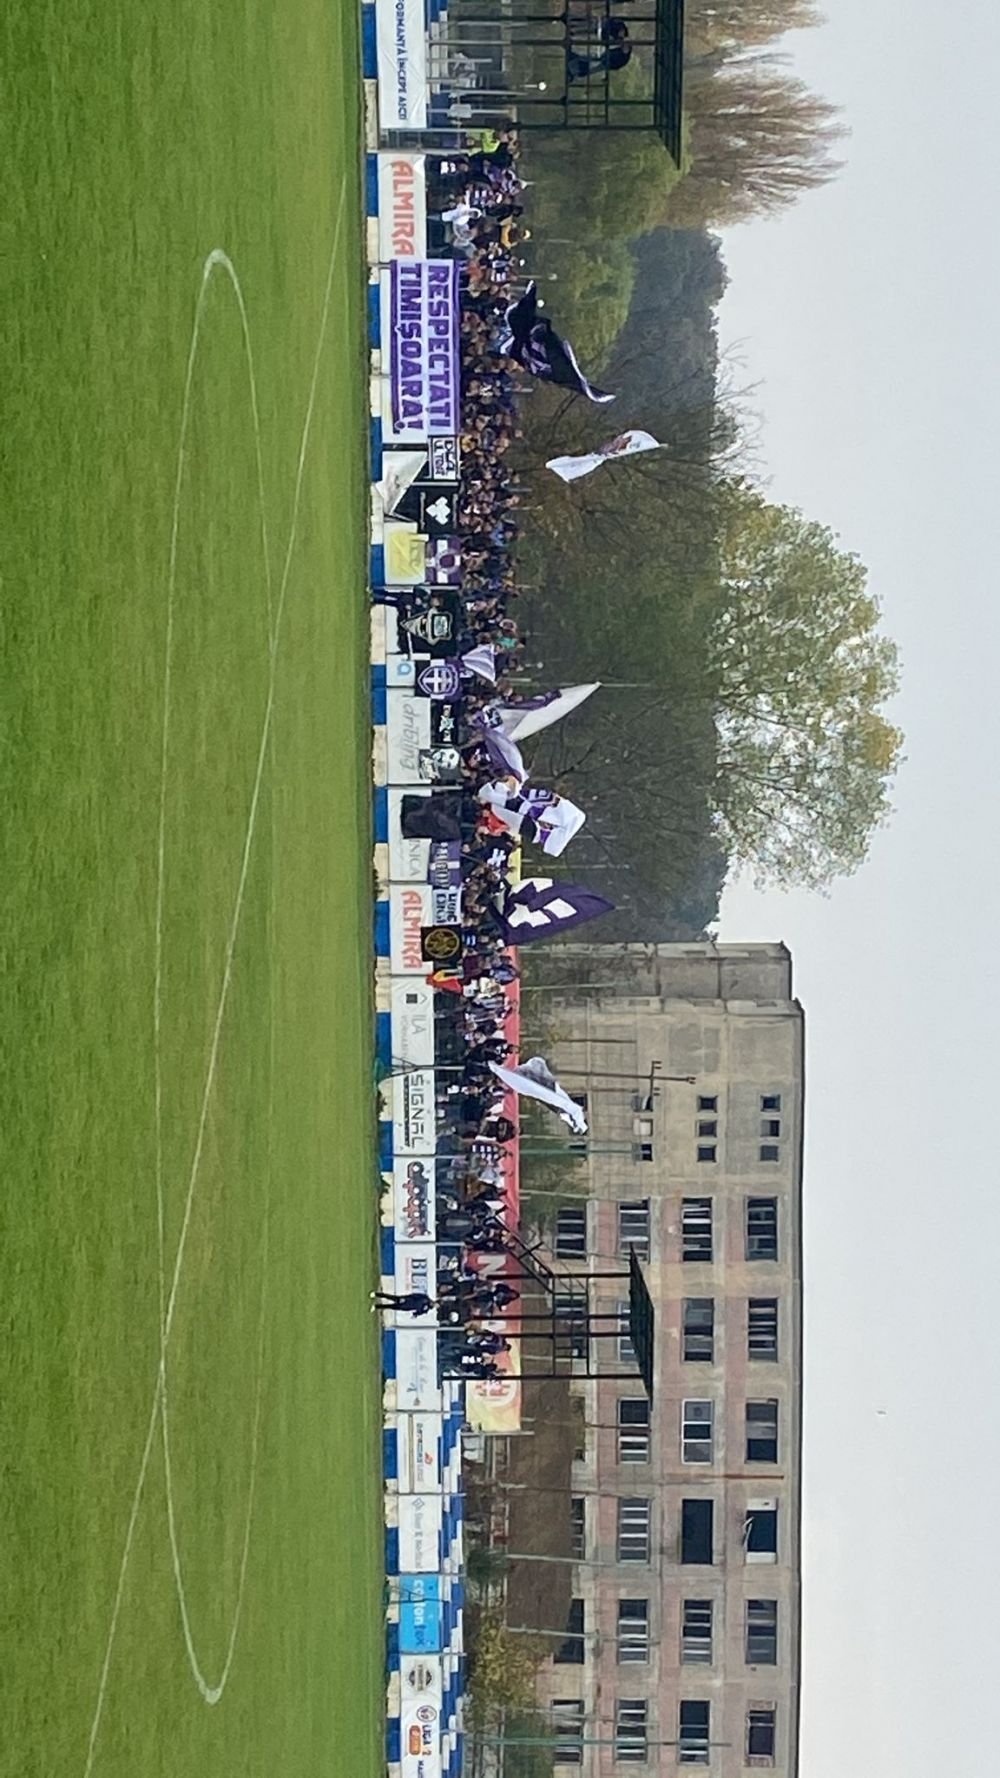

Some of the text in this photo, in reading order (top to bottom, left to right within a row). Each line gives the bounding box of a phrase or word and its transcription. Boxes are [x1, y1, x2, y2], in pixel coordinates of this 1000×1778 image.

[391, 161, 415, 257] ALMIRA
[395, 263, 423, 430] TIMIȘOARA!
[425, 265, 450, 428] RESPECTAȚI
[401, 891, 423, 969] ALMIRA
[411, 1074, 424, 1148] SIGNAL
